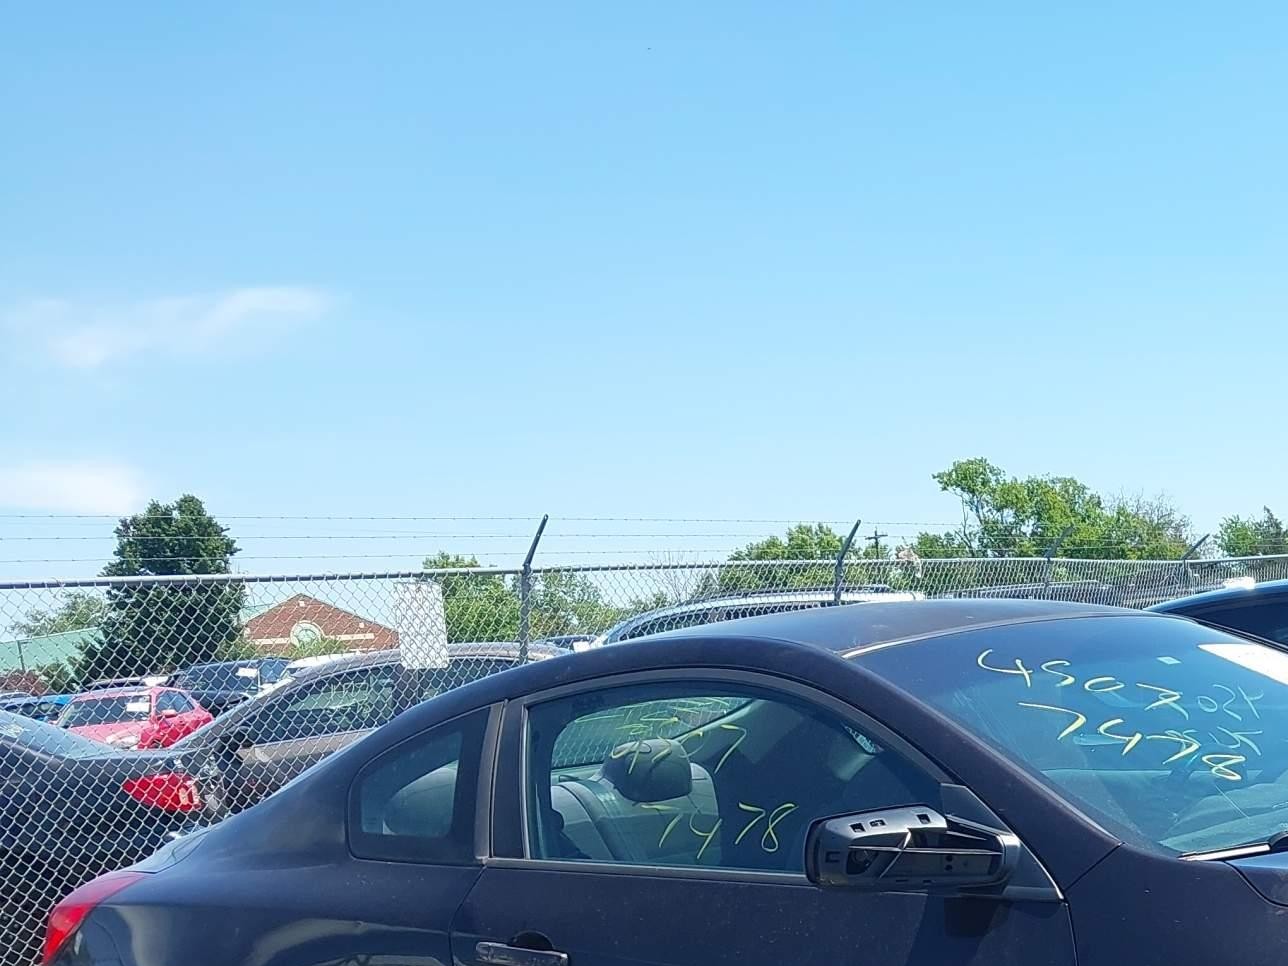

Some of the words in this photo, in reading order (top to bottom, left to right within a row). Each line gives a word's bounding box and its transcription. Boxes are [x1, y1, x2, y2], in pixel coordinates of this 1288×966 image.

[977, 648, 1183, 711] 4507
[1017, 701, 1246, 781] 7478
[641, 802, 800, 860] 7478
